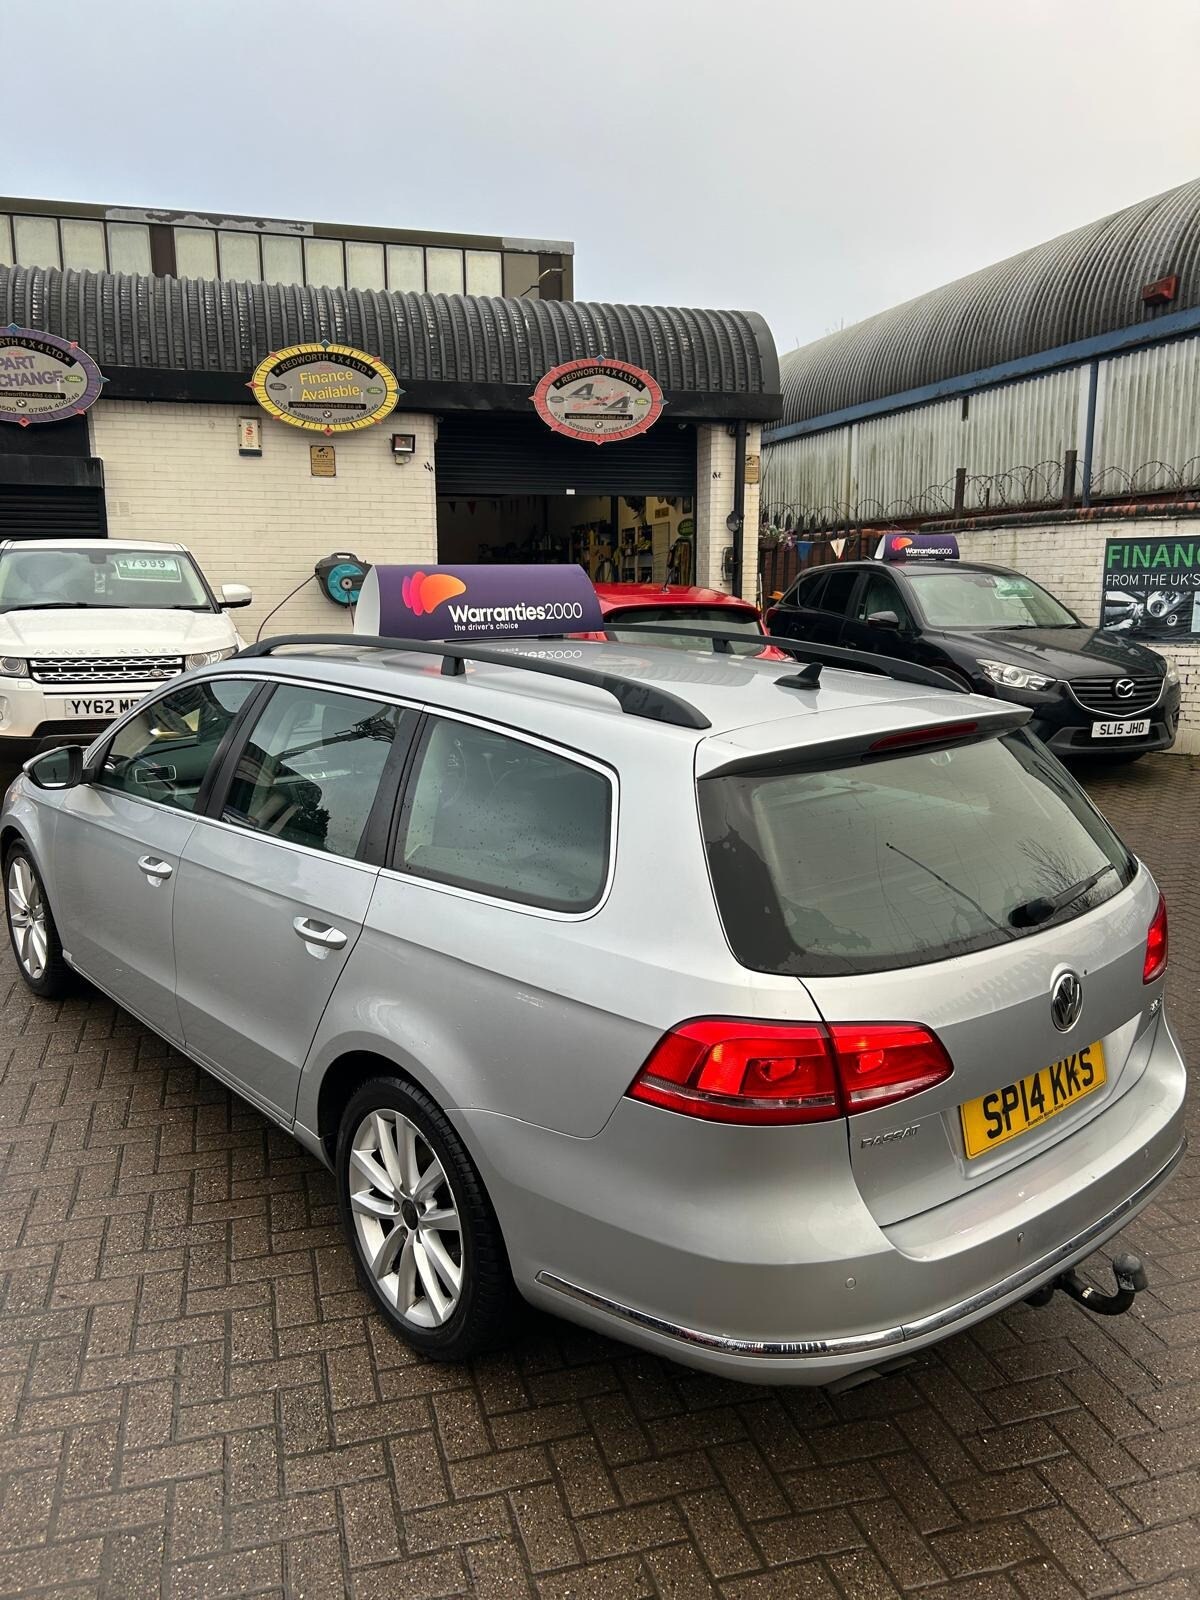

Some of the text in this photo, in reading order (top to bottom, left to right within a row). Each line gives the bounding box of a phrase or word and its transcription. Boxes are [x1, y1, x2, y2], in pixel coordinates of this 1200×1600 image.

[29, 341, 36, 349] X
[45, 346, 63, 359] LTD
[280, 353, 329, 371] REDWORTH
[339, 356, 345, 364] X
[351, 361, 368, 373] LTD
[300, 370, 353, 384] Finance
[561, 367, 604, 383] REDWORTH
[623, 374, 638, 385] LTD
[301, 384, 360, 401] Available
[566, 383, 595, 398] 4
[603, 396, 631, 413] 4
[1105, 574, 1138, 586] FROM
[1142, 574, 1167, 586] THE
[448, 602, 583, 623] Warranties2000
[454, 622, 519, 632] the driver's choice
[71, 700, 115, 714] YY62
[1099, 722, 1145, 735] SL15 JHO
[982, 1047, 1095, 1139] SP14 KKS
[860, 1124, 921, 1149] PASSAT
